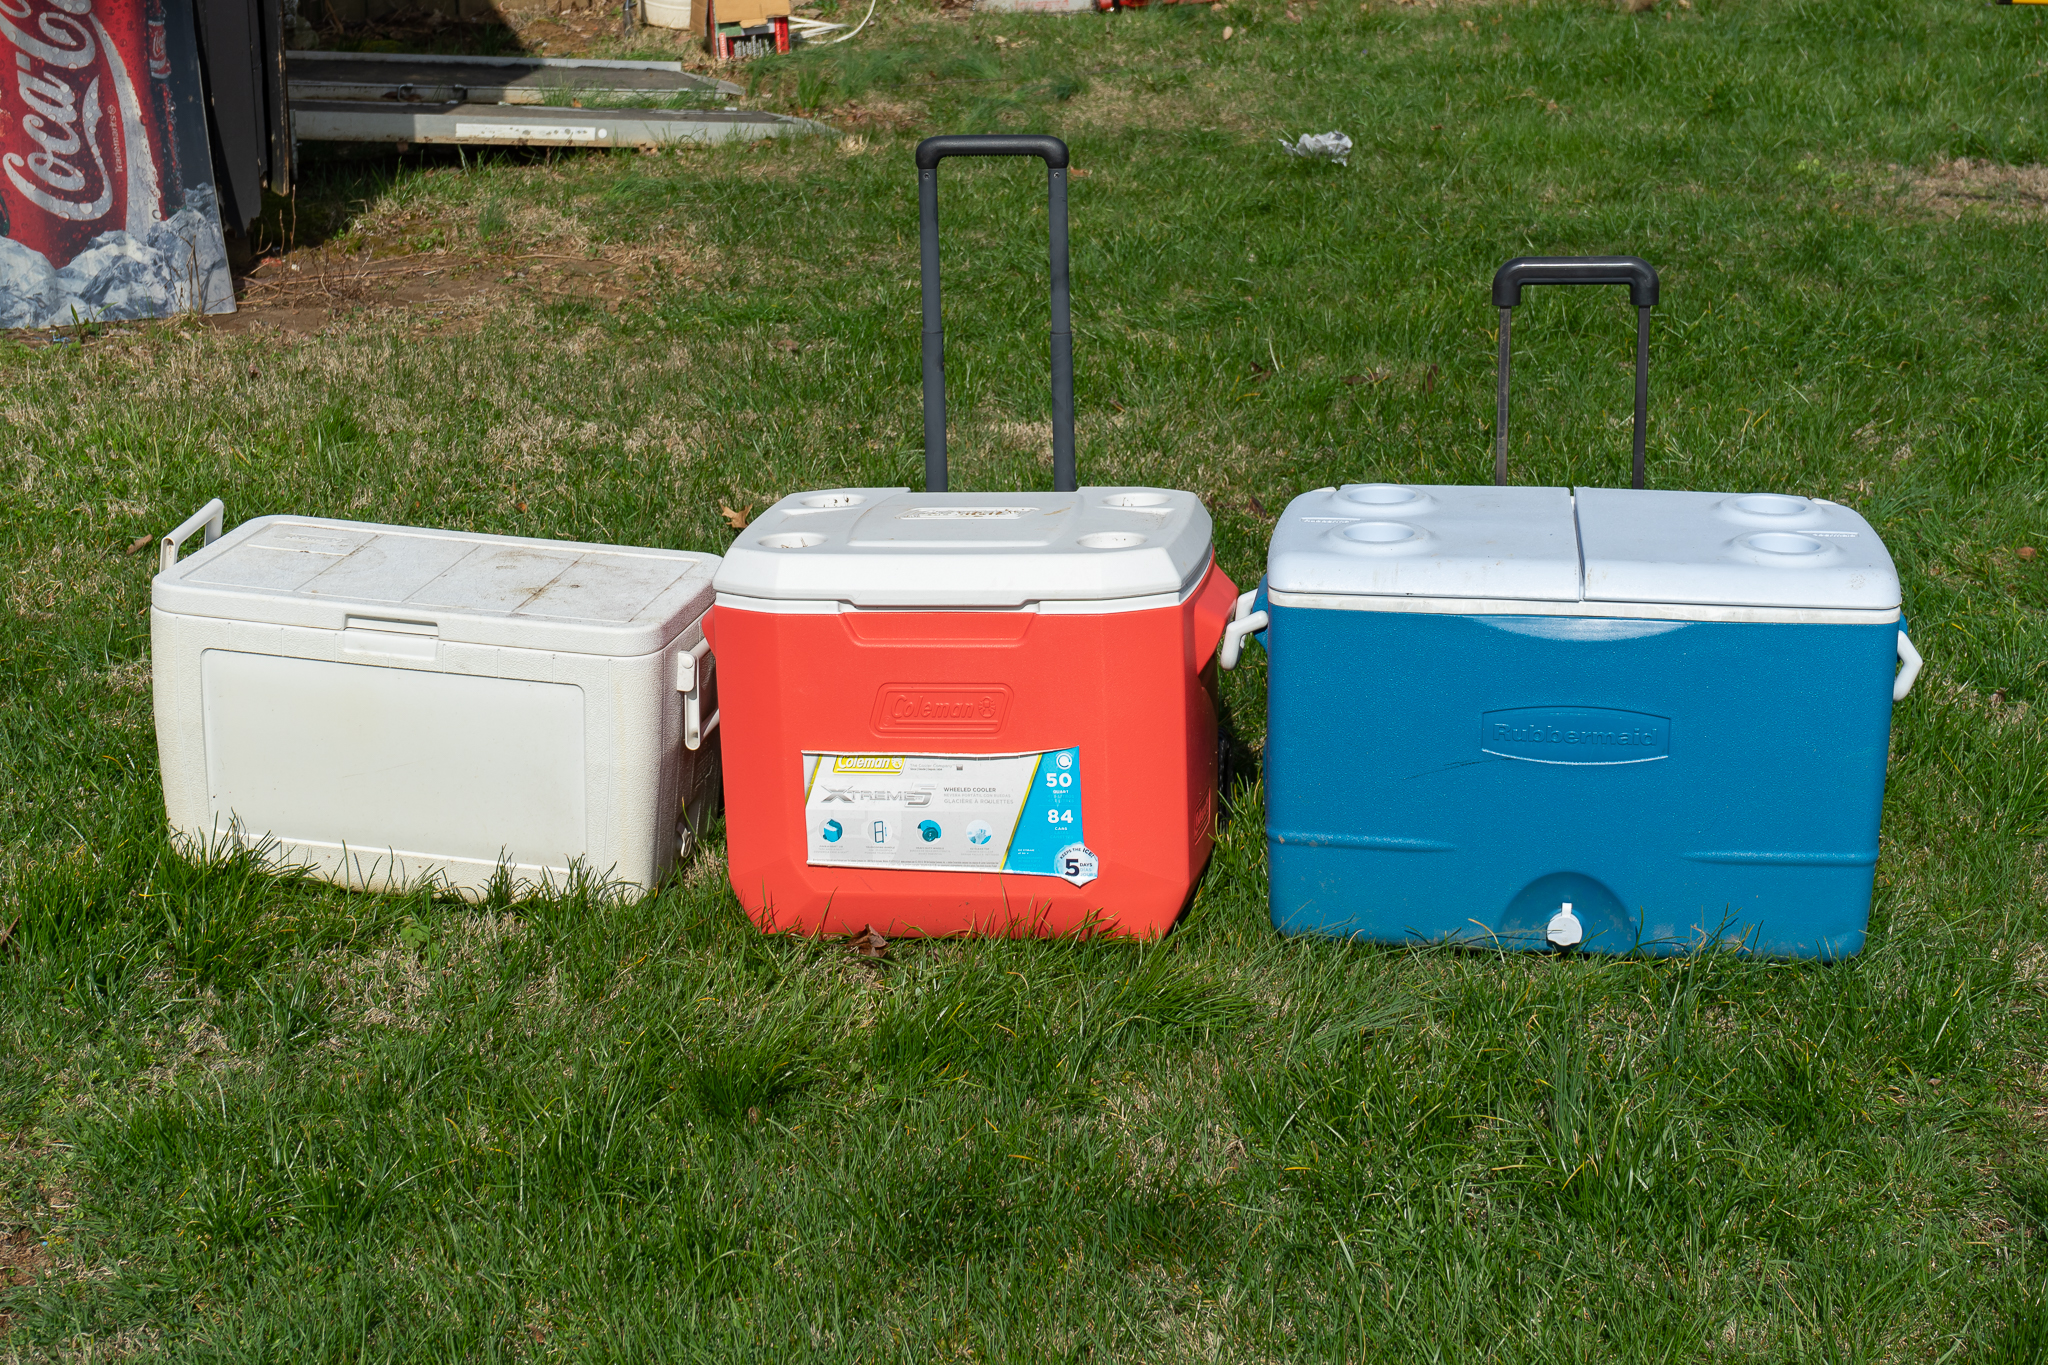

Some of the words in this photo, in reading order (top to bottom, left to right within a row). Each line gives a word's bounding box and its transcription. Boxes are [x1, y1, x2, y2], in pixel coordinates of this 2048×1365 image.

[891, 694, 975, 719] Coleman
[1493, 723, 1658, 746] Rubbermaid
[838, 756, 891, 769] Coleman
[1046, 772, 1072, 787] 50
[1047, 809, 1074, 824] 84
[1065, 858, 1080, 877] 5
